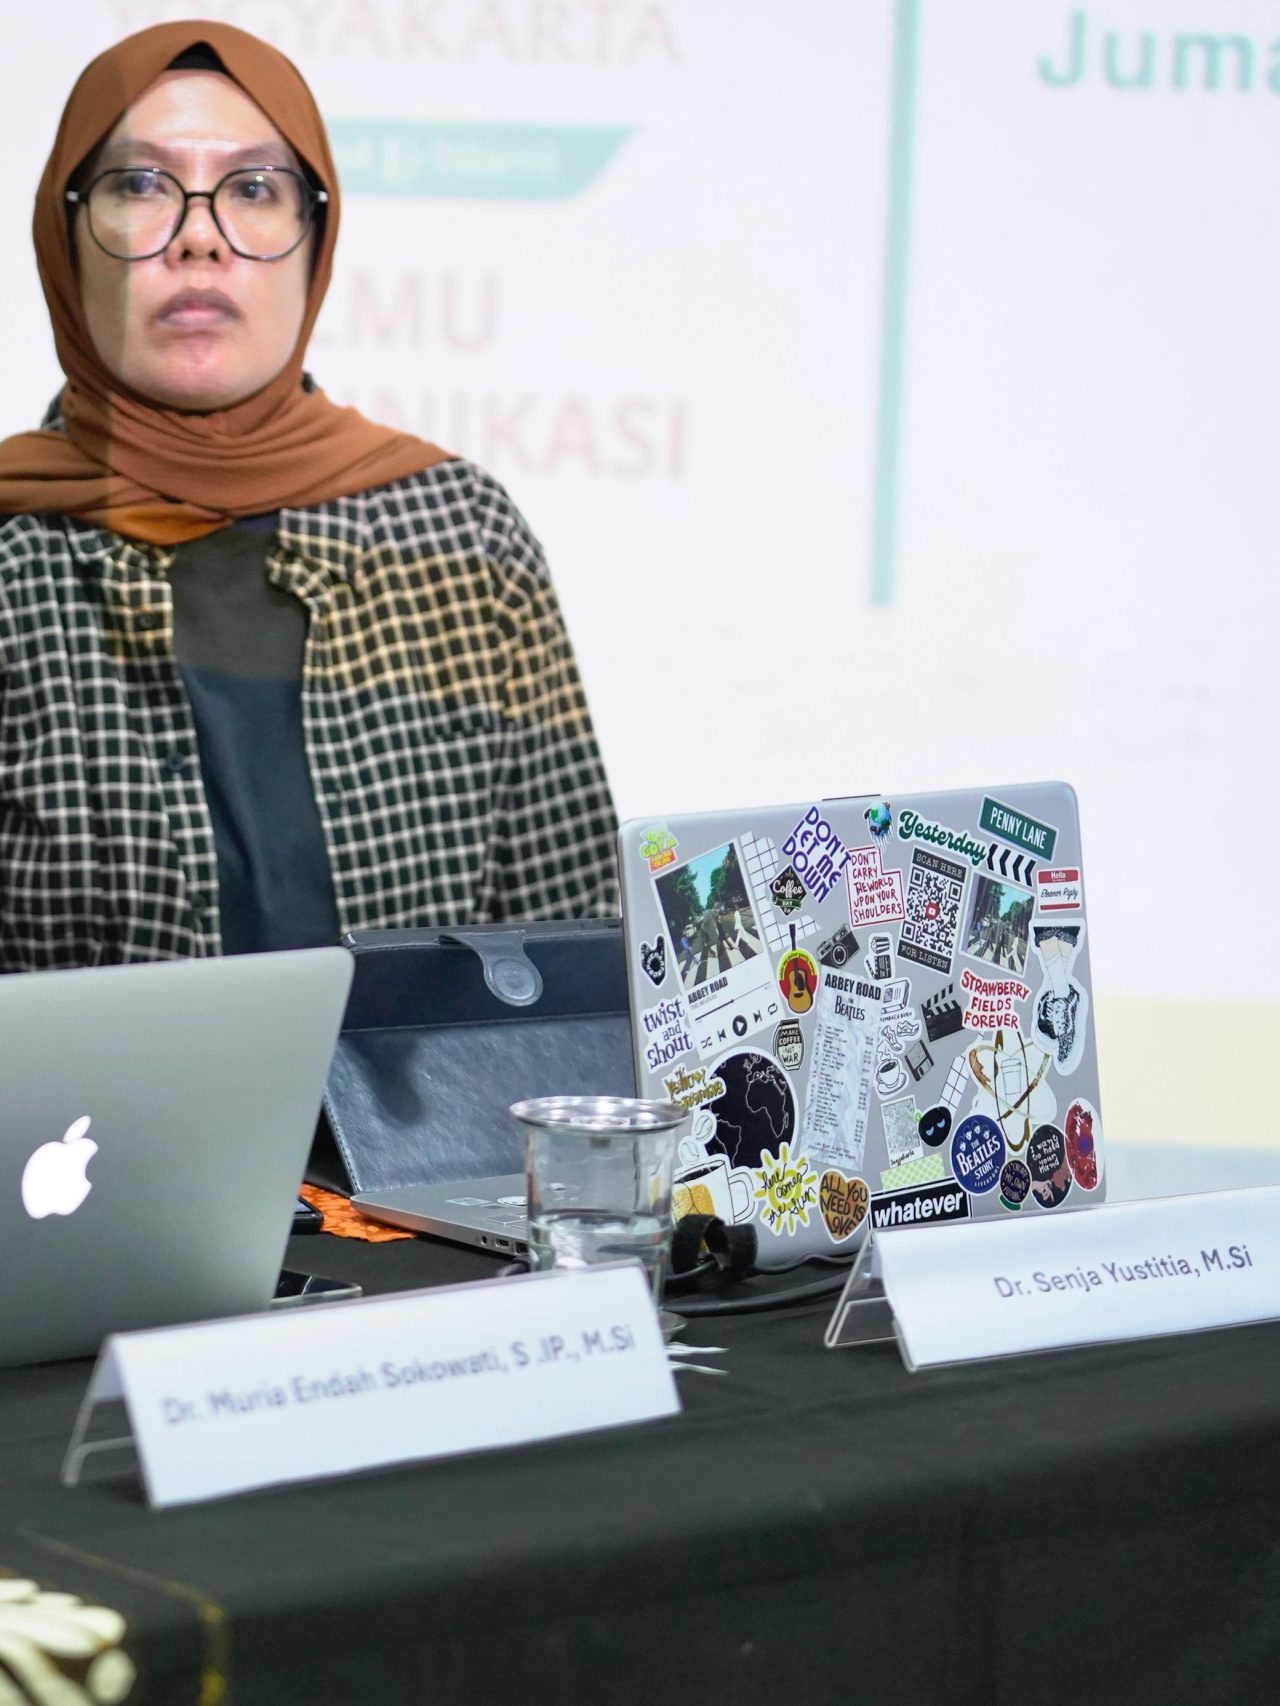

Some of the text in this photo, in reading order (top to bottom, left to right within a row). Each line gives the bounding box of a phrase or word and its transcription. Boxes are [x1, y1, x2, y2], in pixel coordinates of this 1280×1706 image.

[805, 806, 852, 870] DON'T
[899, 810, 986, 866] Yesterday
[990, 806, 1047, 849] PENNY LANE
[793, 820, 841, 888] LET ME
[851, 851, 877, 866] DON'T
[916, 853, 963, 878] SCAN HERE
[782, 836, 829, 903] DOWN
[853, 866, 878, 881] CARRY
[772, 879, 803, 899] Coffee
[854, 888, 898, 907] UPON YOUR
[867, 877, 894, 892] WORLD
[853, 903, 902, 923] SHOULDERS
[901, 945, 948, 968] FOR LISTEN
[687, 976, 729, 1005] ABBEY ROAD
[824, 973, 881, 1000] ABBEY ROAD
[961, 971, 1030, 1000] STRAWBERRY
[643, 996, 686, 1033] twist
[834, 995, 866, 1021] BEATLES
[971, 996, 1012, 1012] FIELDS
[662, 1020, 682, 1041] and
[963, 1010, 1018, 1030] FOREVER
[647, 1031, 693, 1069] shout
[779, 1035, 801, 1046] COFFEE
[782, 1053, 799, 1063] WAR
[955, 1135, 1001, 1176] BEATLES
[974, 1158, 994, 1180] STORY
[821, 1174, 868, 1203] ALL YOU
[820, 1194, 866, 1221] NEED IS
[874, 1191, 964, 1228] whatever
[825, 1214, 857, 1236] LOVE
[993, 1244, 1254, 1298] Dr. Senja Yustitia, M.Si
[161, 1397, 203, 1425] Dr.
[208, 1382, 288, 1416] Muria
[290, 1370, 377, 1403] Endah
[380, 1345, 509, 1388] Sokowati,
[581, 1324, 637, 1356] M.Si
